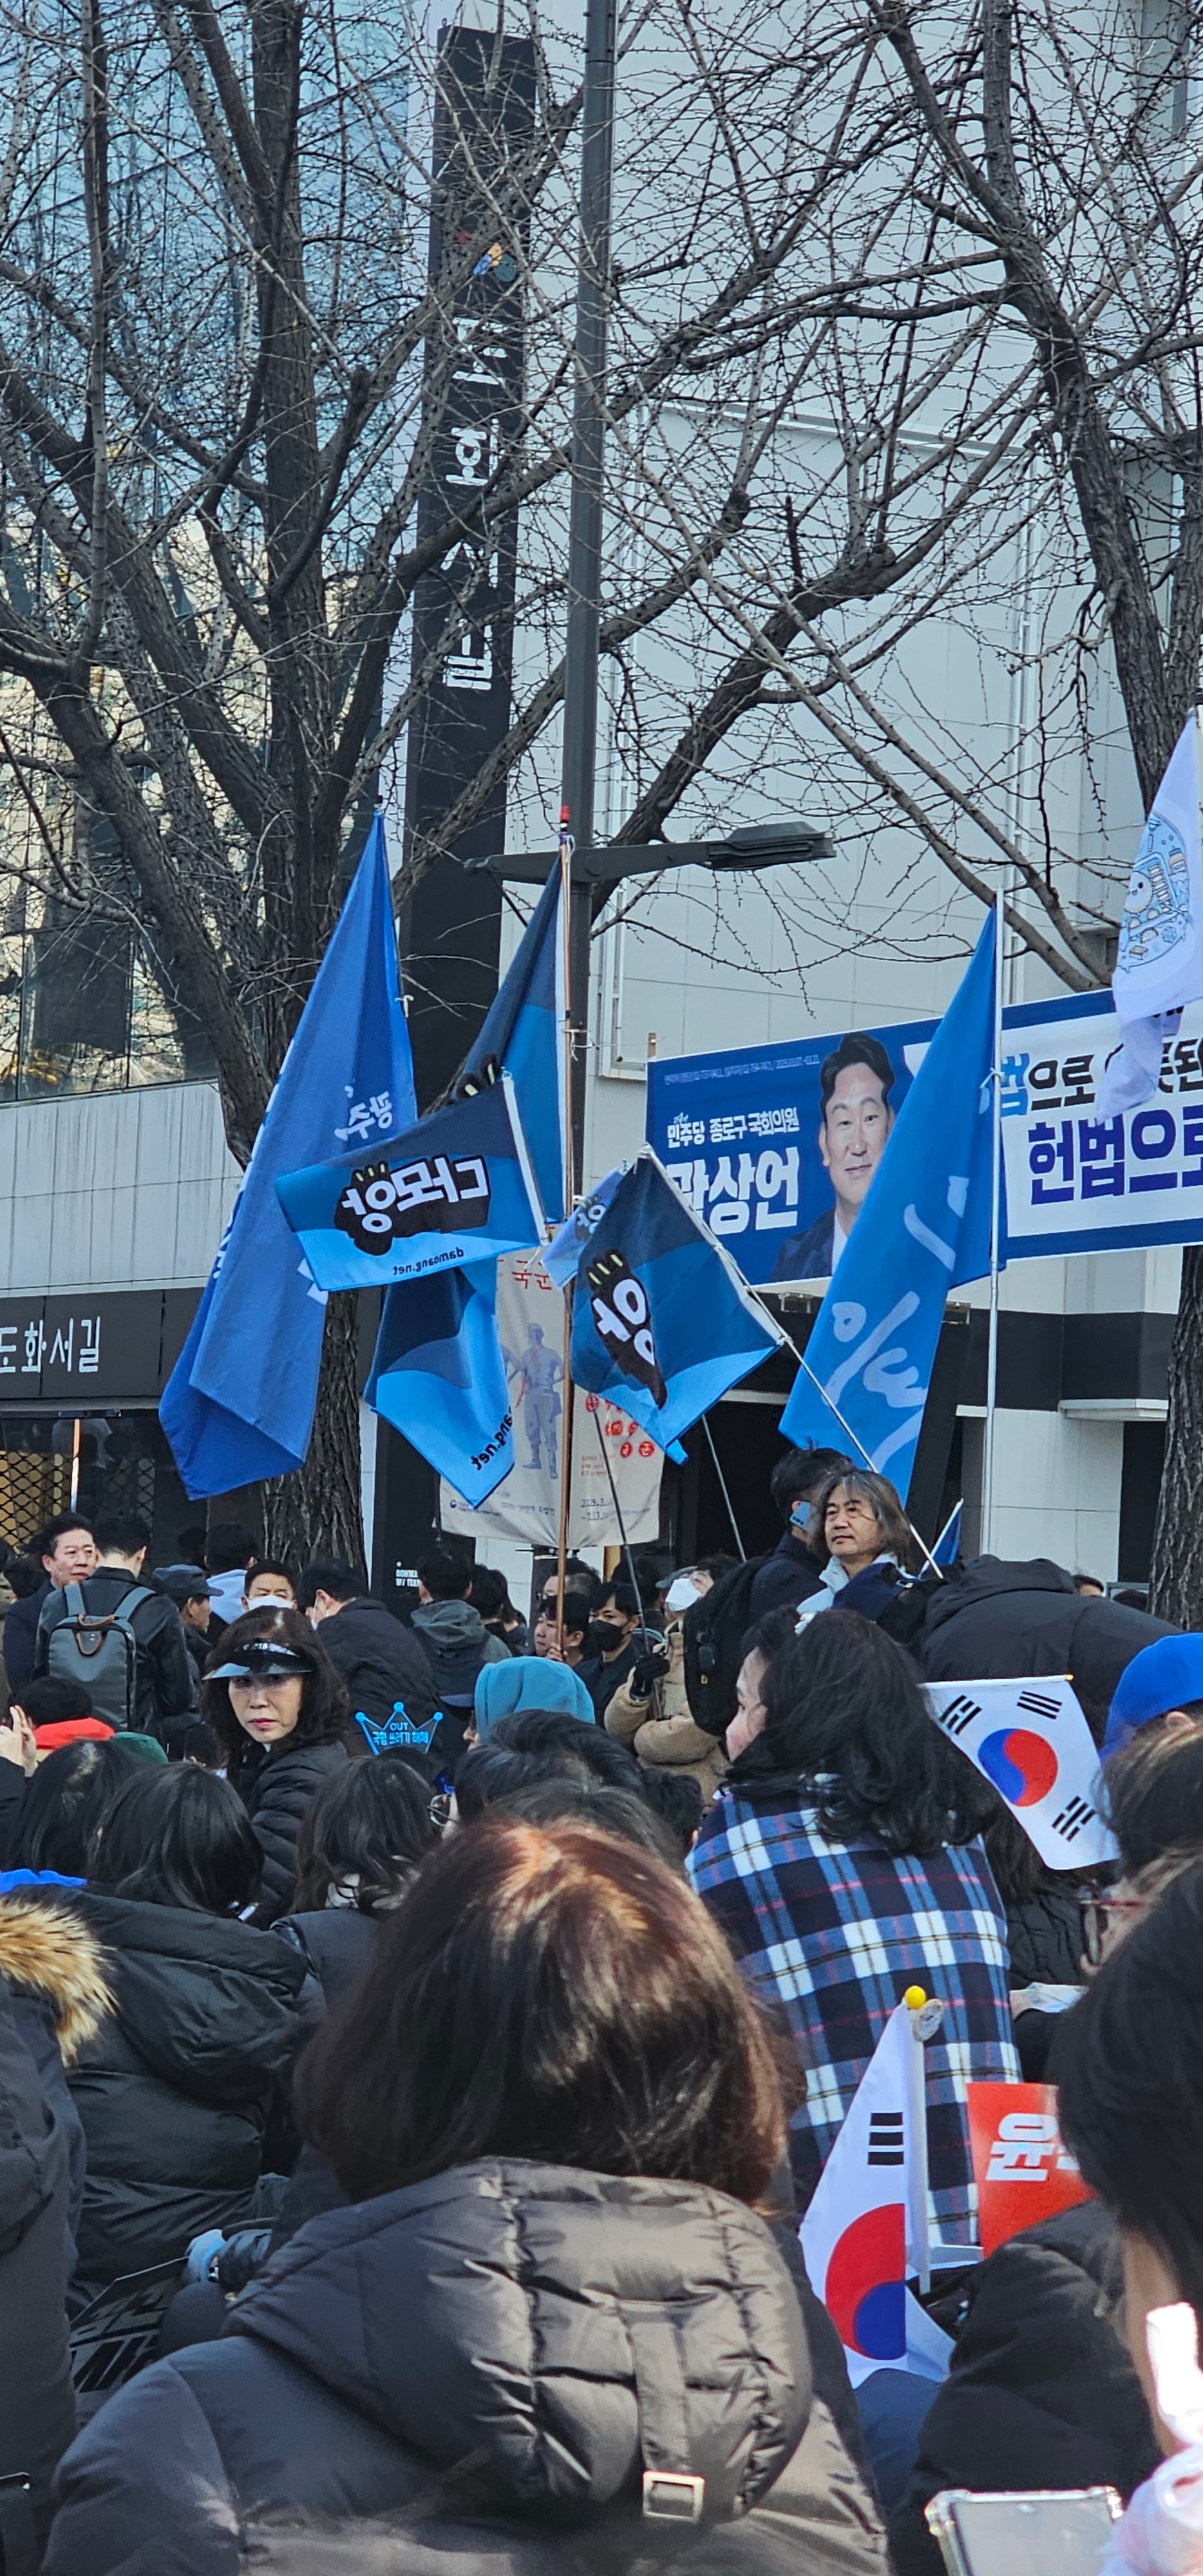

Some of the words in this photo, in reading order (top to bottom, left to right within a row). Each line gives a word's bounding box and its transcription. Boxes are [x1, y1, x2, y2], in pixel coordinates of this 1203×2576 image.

[667, 1121, 705, 1148] 민주당
[709, 1115, 748, 1143] 종로구
[748, 1107, 800, 1137] 국회의원
[390, 1722, 408, 1731] OUT
[985, 2113, 1080, 2182] 윤
